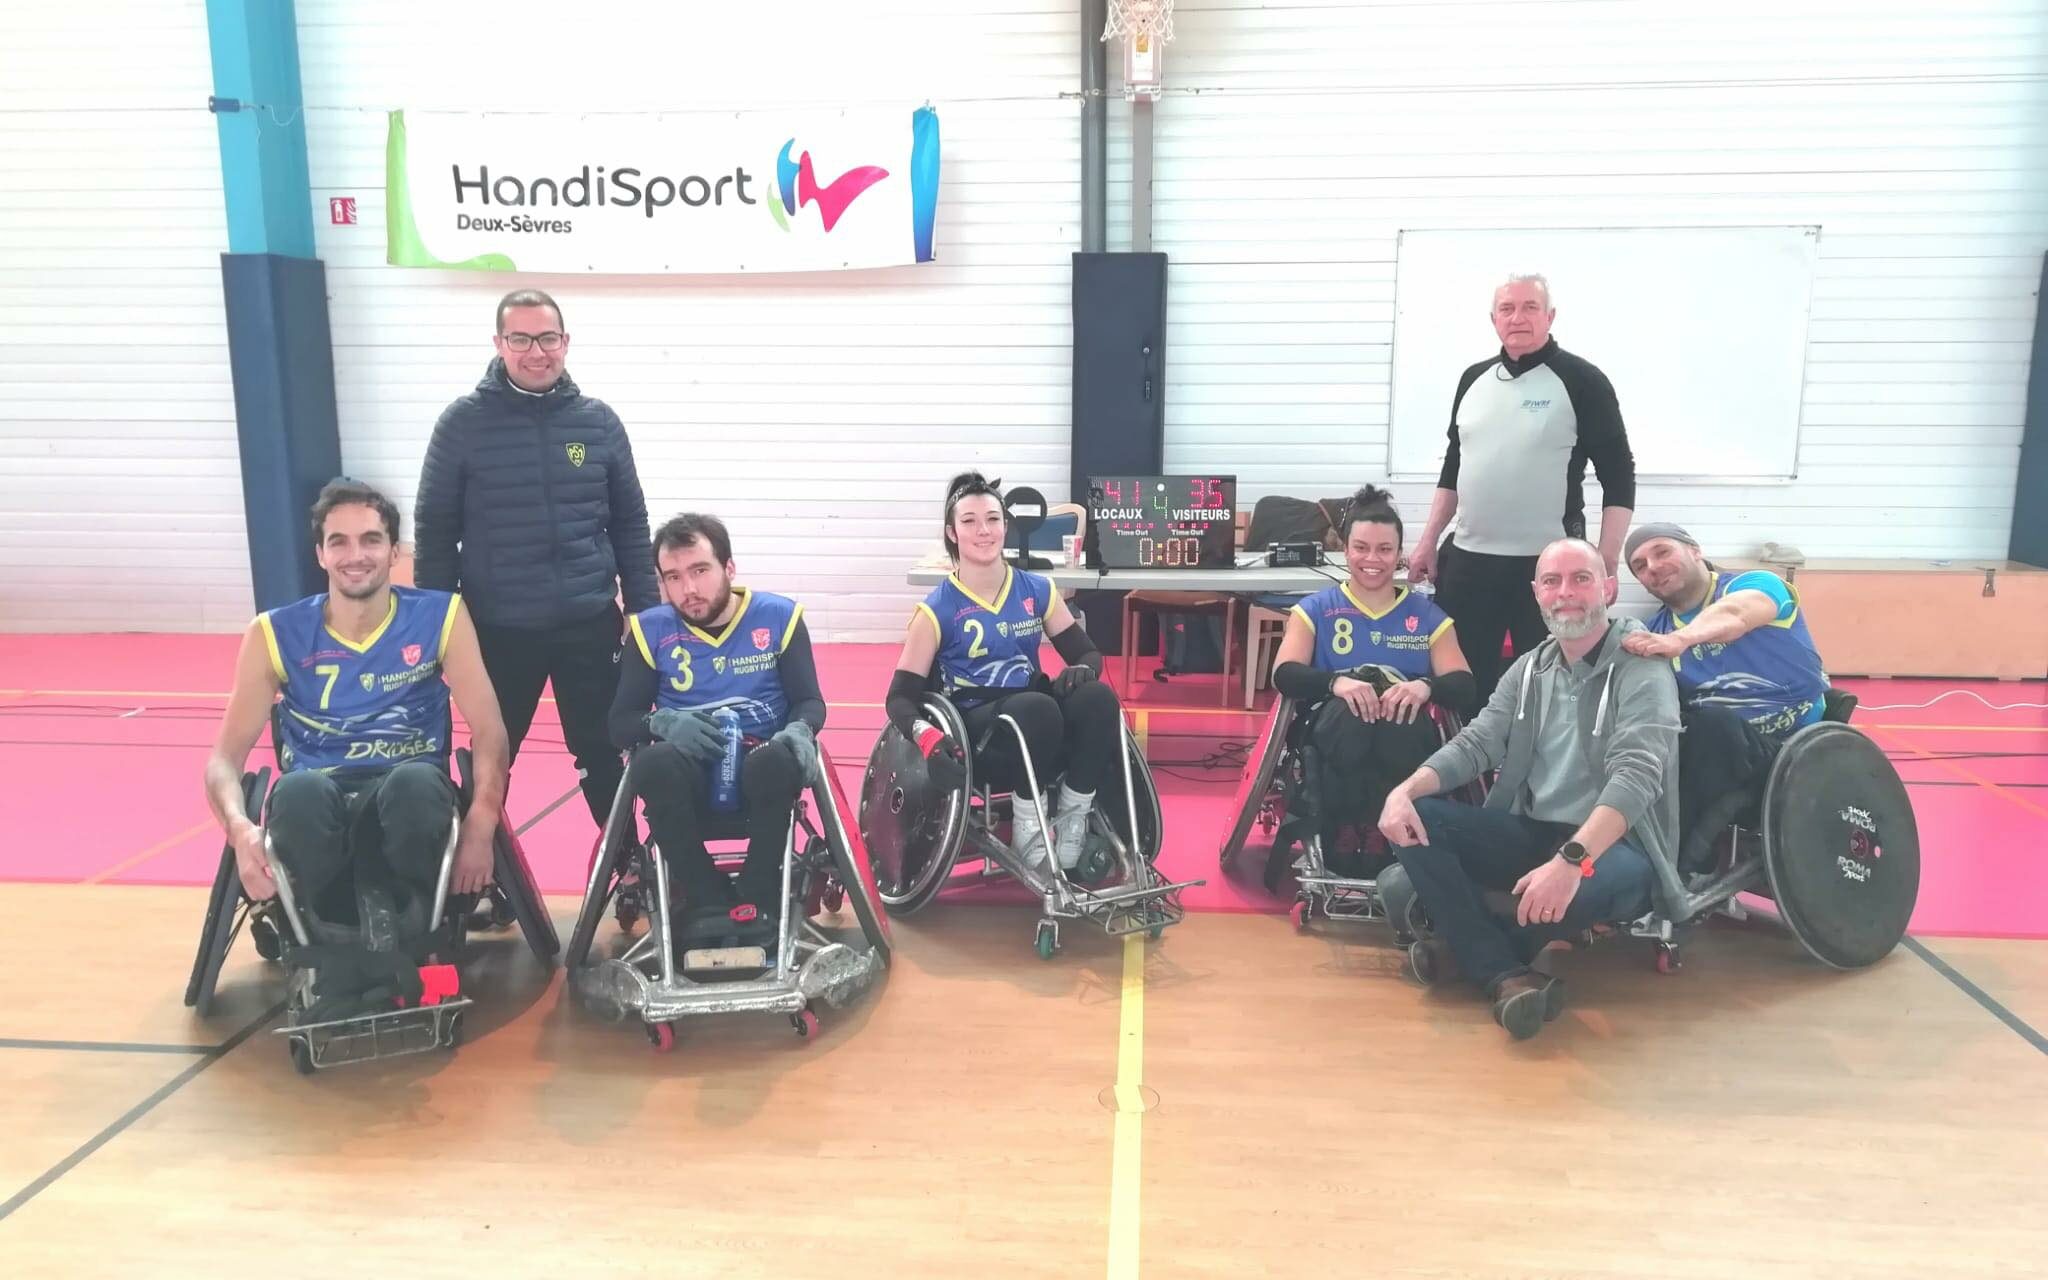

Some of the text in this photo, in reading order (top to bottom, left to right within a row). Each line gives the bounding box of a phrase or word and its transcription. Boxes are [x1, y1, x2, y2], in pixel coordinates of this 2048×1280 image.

[452, 164, 756, 218] HandiSport
[456, 213, 572, 234] Deux-Sèvres
[1153, 495, 1168, 520] 4
[1190, 479, 1224, 508] 35
[1094, 508, 1143, 520] LOCAUX
[1172, 509, 1231, 521] VISITEURS
[1139, 537, 1199, 566] 0:00
[963, 619, 989, 659] 2
[1332, 618, 1354, 655] 8
[670, 646, 694, 692] 3
[315, 664, 340, 710] 7
